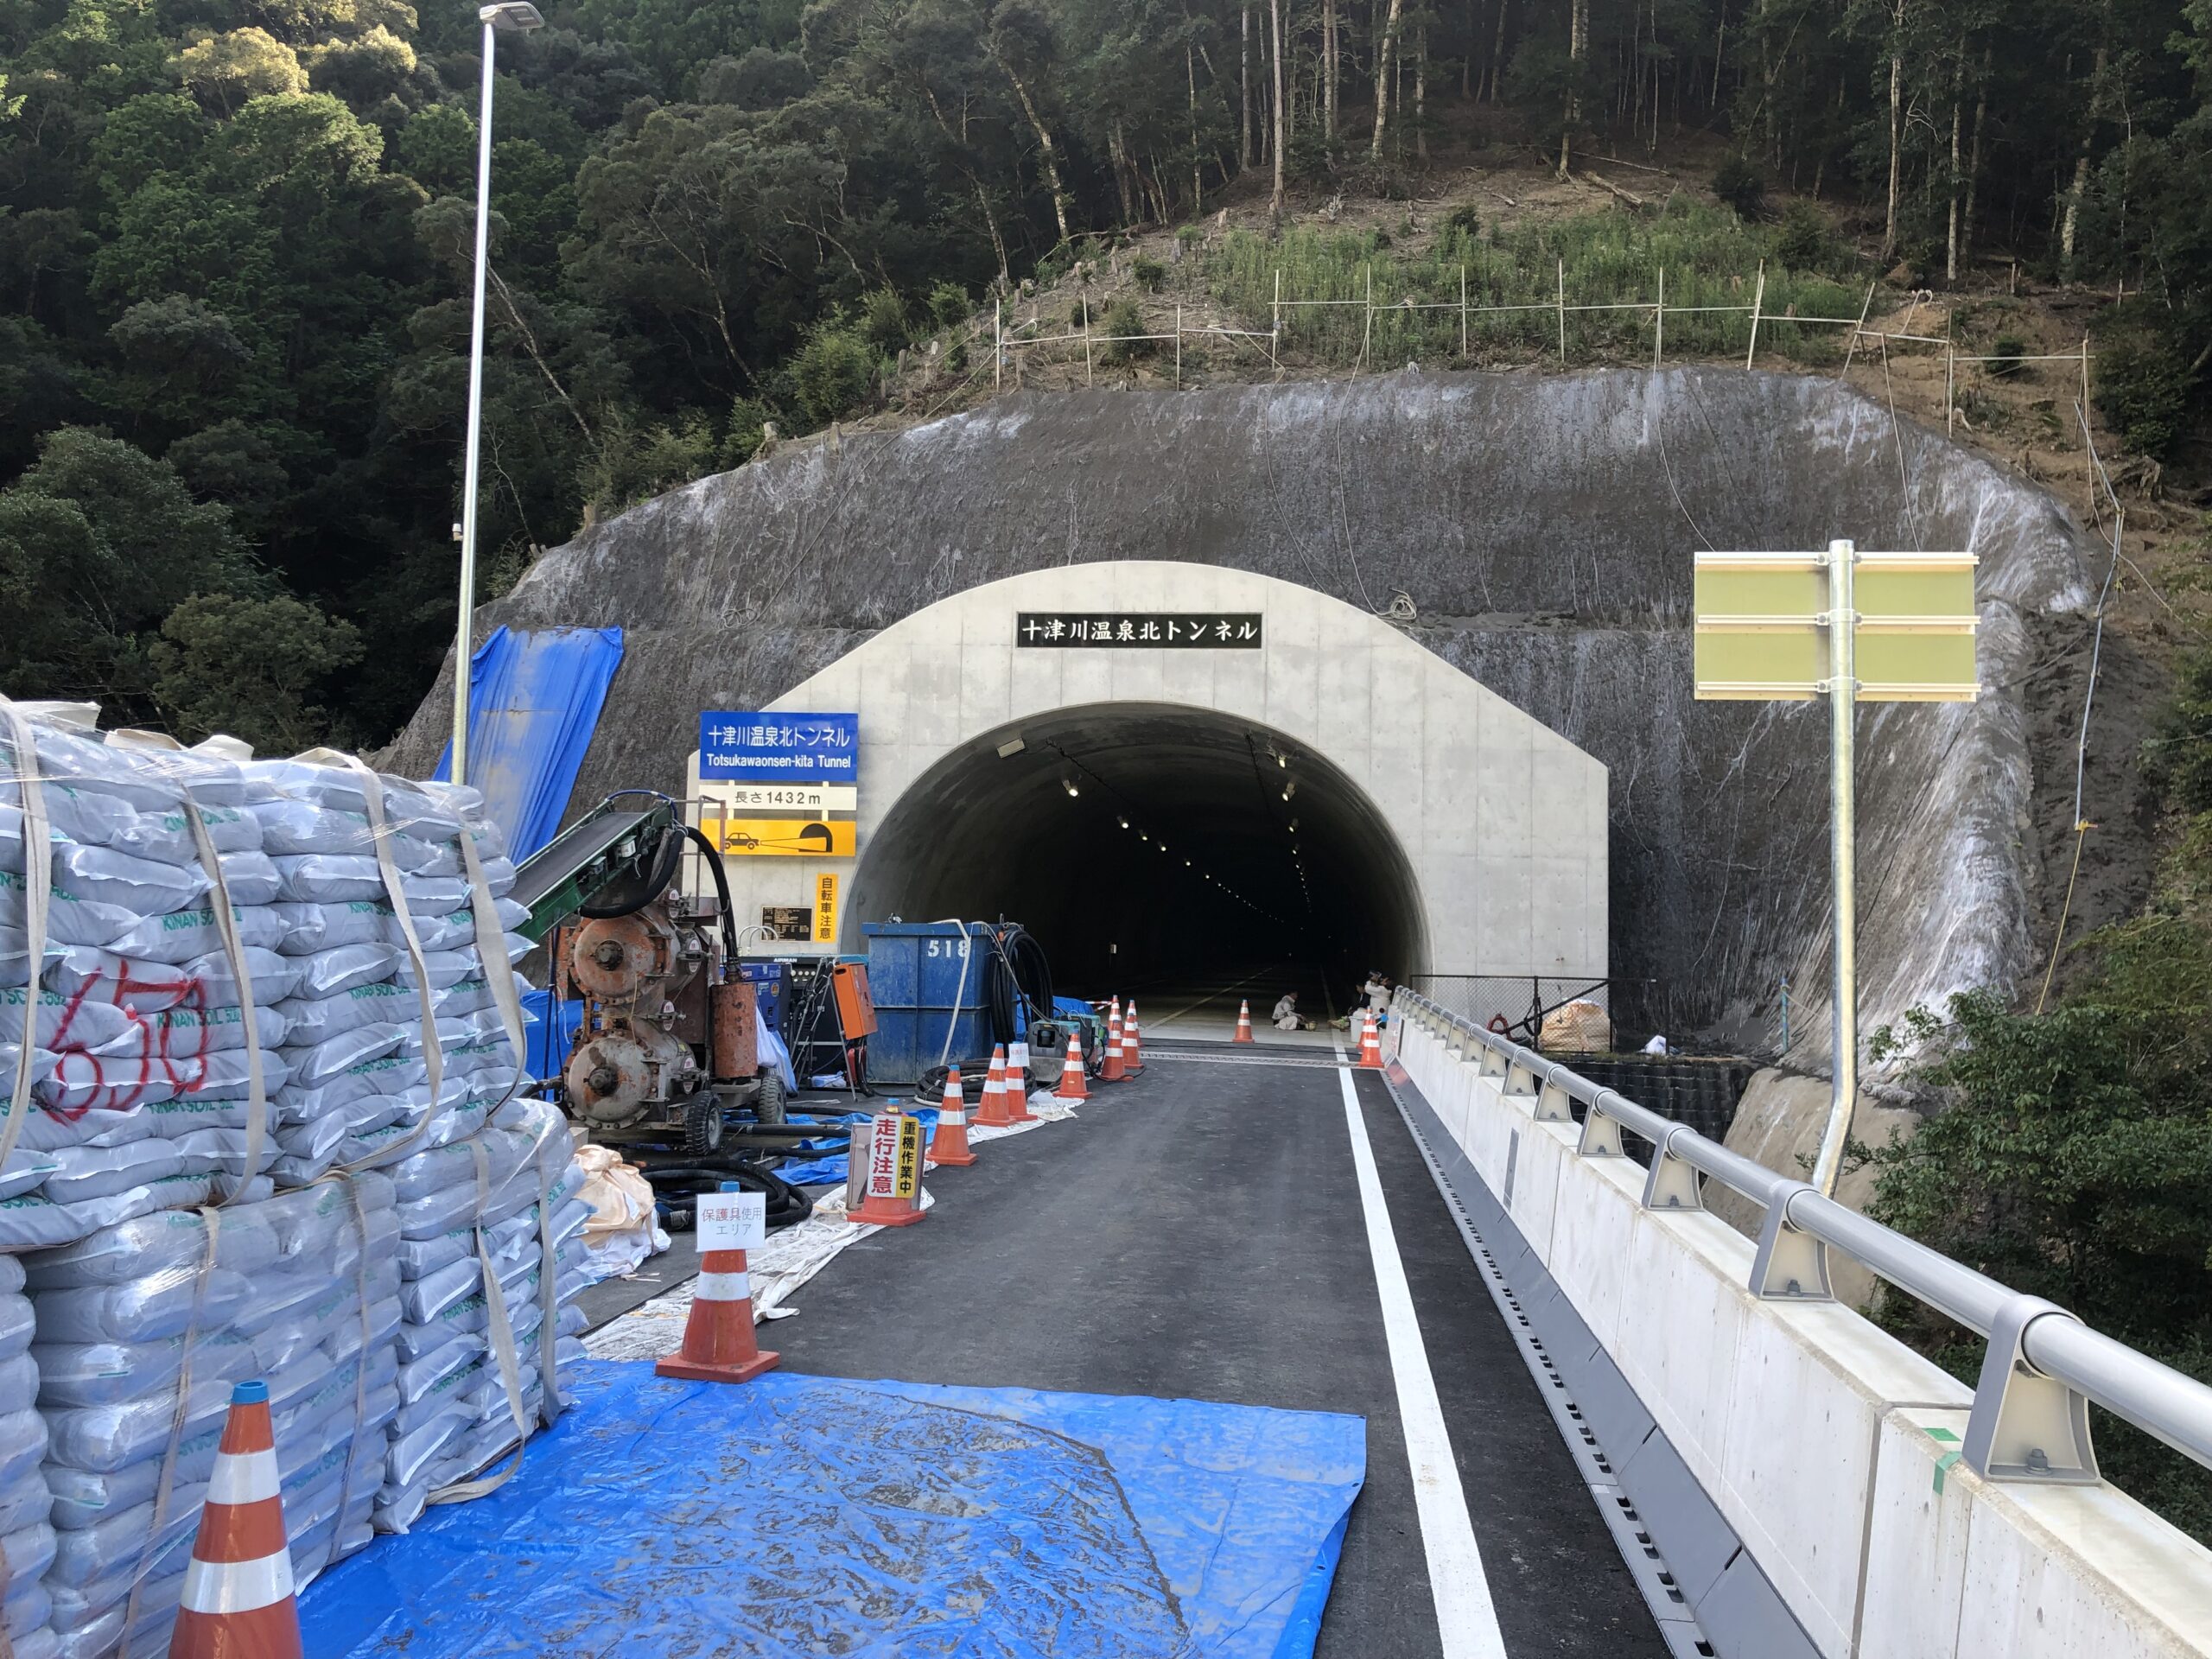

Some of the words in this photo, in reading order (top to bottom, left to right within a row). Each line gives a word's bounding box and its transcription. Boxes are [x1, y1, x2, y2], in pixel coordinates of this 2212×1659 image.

[1021, 619, 1258, 642] 十津川温泉北トンネル
[708, 724, 851, 748] 十津川温泉北トンネル
[707, 753, 814, 768] Totsukawaonsen-kita
[817, 754, 851, 769] Tunnel
[819, 877, 833, 939] 自転車注意
[927, 939, 969, 958] 518
[871, 1119, 897, 1195] 走行注意
[899, 1121, 917, 1194] 重機作業中
[702, 1207, 762, 1222] 保護具使用
[715, 1224, 752, 1236] エリア
